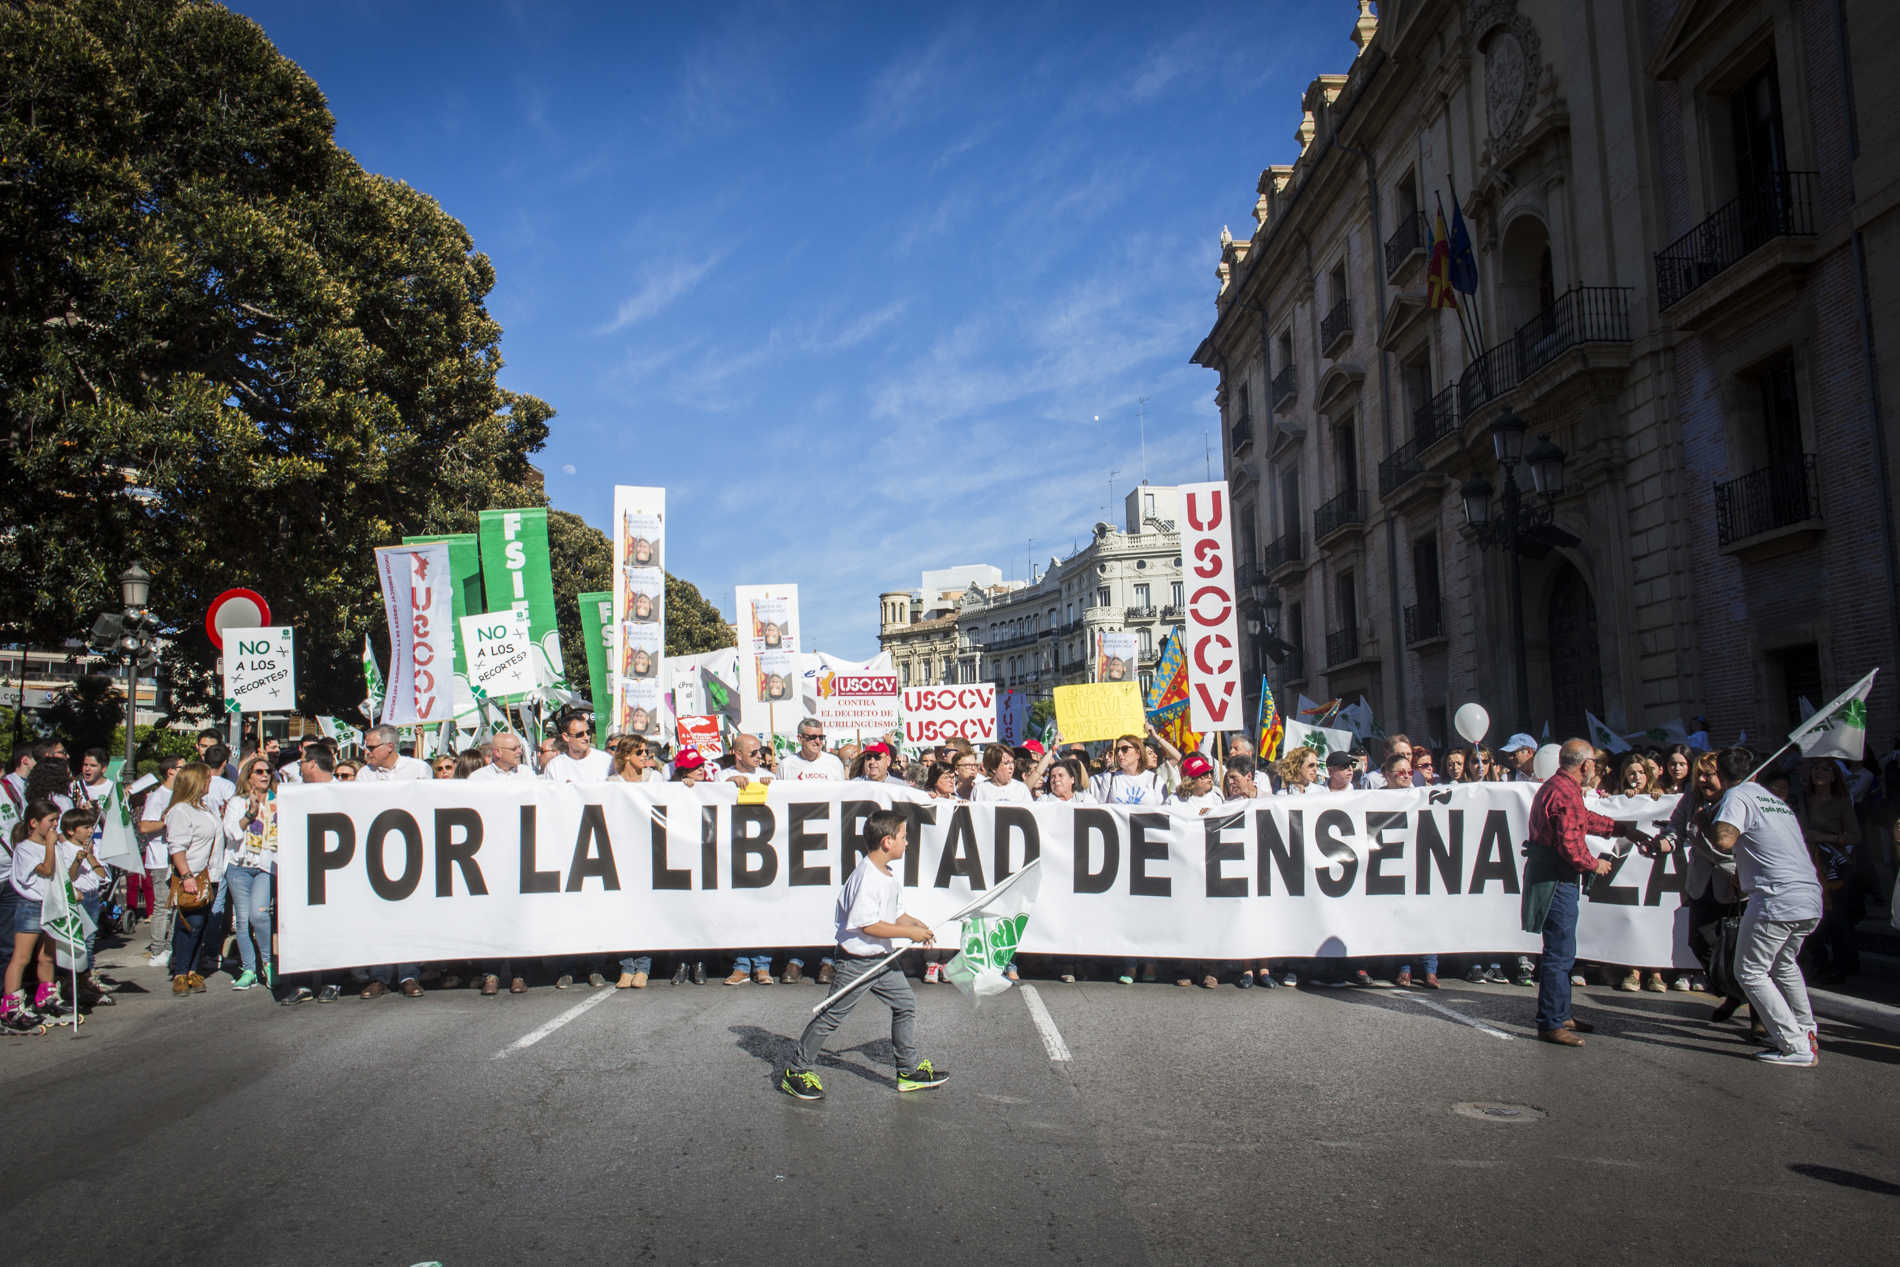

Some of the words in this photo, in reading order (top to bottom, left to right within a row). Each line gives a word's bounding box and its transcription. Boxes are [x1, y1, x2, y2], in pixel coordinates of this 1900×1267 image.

[1186, 490, 1236, 722] USOCV
[477, 625, 507, 642] NO
[239, 640, 271, 656] NO
[477, 648, 486, 658] A
[491, 643, 515, 656] LOS
[236, 661, 245, 671] A
[251, 660, 276, 671] LOS
[478, 651, 527, 682] RECORTES?
[233, 669, 289, 697] RECORTES?
[839, 678, 895, 692] USOCV
[904, 688, 994, 712] USOCV
[906, 717, 995, 742] USOCV
[307, 808, 489, 906] POR
[519, 804, 621, 894] LA
[650, 799, 1040, 891] LIBERTAD
[1073, 808, 1172, 897] DE
[1205, 789, 1689, 908] ENSEÑAZA
